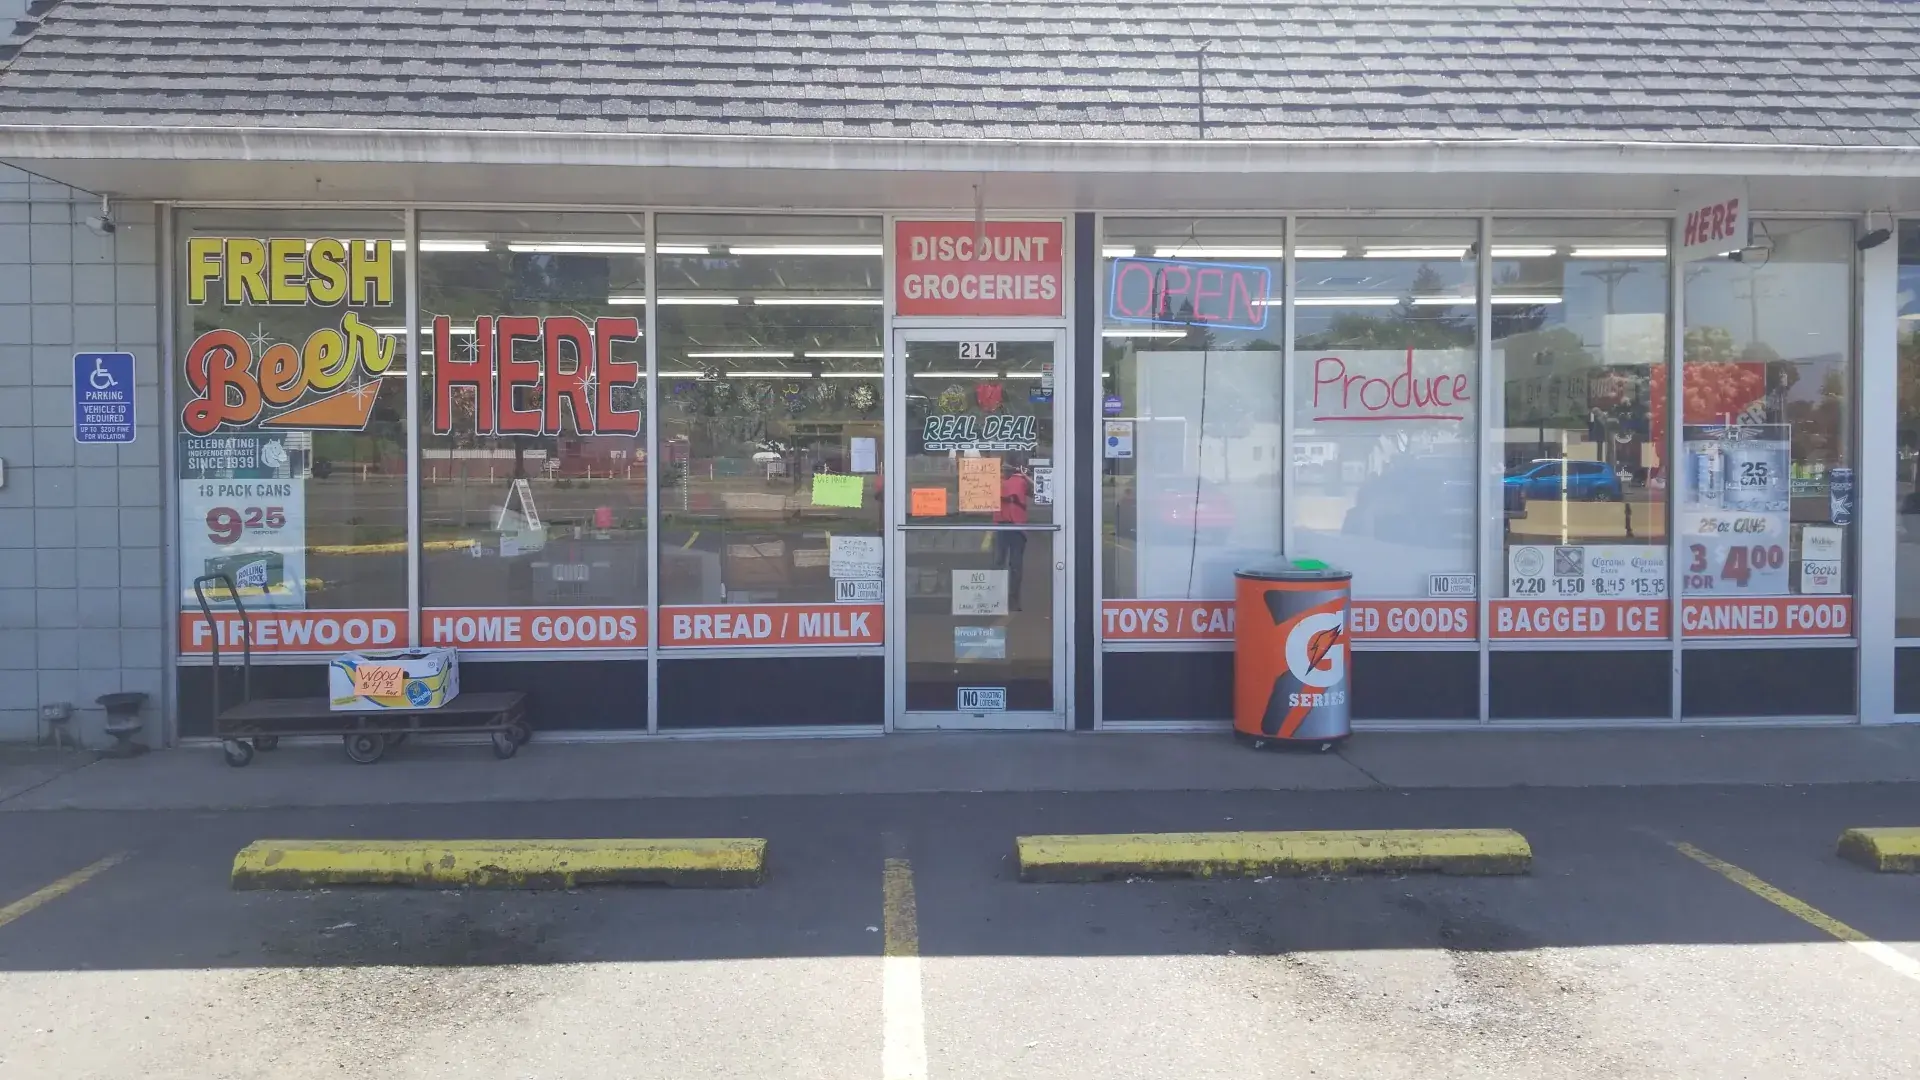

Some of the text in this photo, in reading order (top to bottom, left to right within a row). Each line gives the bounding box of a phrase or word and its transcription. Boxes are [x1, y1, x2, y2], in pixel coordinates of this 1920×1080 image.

[1684, 198, 1739, 247] HERE
[911, 236, 1049, 262] DISCOUNT
[186, 237, 394, 307] FRESH
[904, 274, 1056, 300] GROCERIES
[1116, 263, 1265, 324] OPEN
[960, 342, 996, 358] 214
[181, 310, 396, 437] Beer
[432, 315, 641, 437] HERE
[1313, 346, 1471, 410] Produce
[85, 390, 124, 401] PARKING
[83, 405, 127, 414] VEHICLE ID
[86, 414, 124, 423] REQUIRED
[923, 415, 1037, 441] REAL DEAL
[187, 438, 254, 450] CELEBRATING
[924, 441, 1038, 451] GROCERY
[188, 449, 233, 457] INDEPENDENT
[188, 456, 254, 469] SINCE 1939
[1740, 462, 1768, 477] 25
[198, 484, 291, 498] 18 PACK CANS
[1689, 543, 1707, 573] 3
[238, 565, 264, 580] ROLLING
[1804, 562, 1838, 575] Coors
[248, 574, 264, 582] ROCK
[971, 573, 985, 582] NO
[1434, 577, 1449, 592] NO
[1512, 577, 1546, 593] $2.20
[1552, 577, 1585, 593] $1.50
[1630, 577, 1665, 593] $15.95
[1683, 574, 1714, 589] FOR
[841, 582, 856, 598] NO
[673, 611, 871, 640] BREAD / MILK
[1103, 608, 1169, 633] TOYS
[1176, 608, 1183, 633] /
[1386, 607, 1469, 633] GOODS
[1498, 606, 1660, 632] BAGGED ICE
[1682, 605, 1847, 630] CANNED FOOD
[192, 618, 396, 646] FIREWOOD
[433, 615, 638, 642] HOME GOODS
[1285, 610, 1345, 688] G
[358, 666, 402, 681] Wood
[963, 691, 1002, 706] NO SOLICITING
[1288, 690, 1345, 707] SERIES
